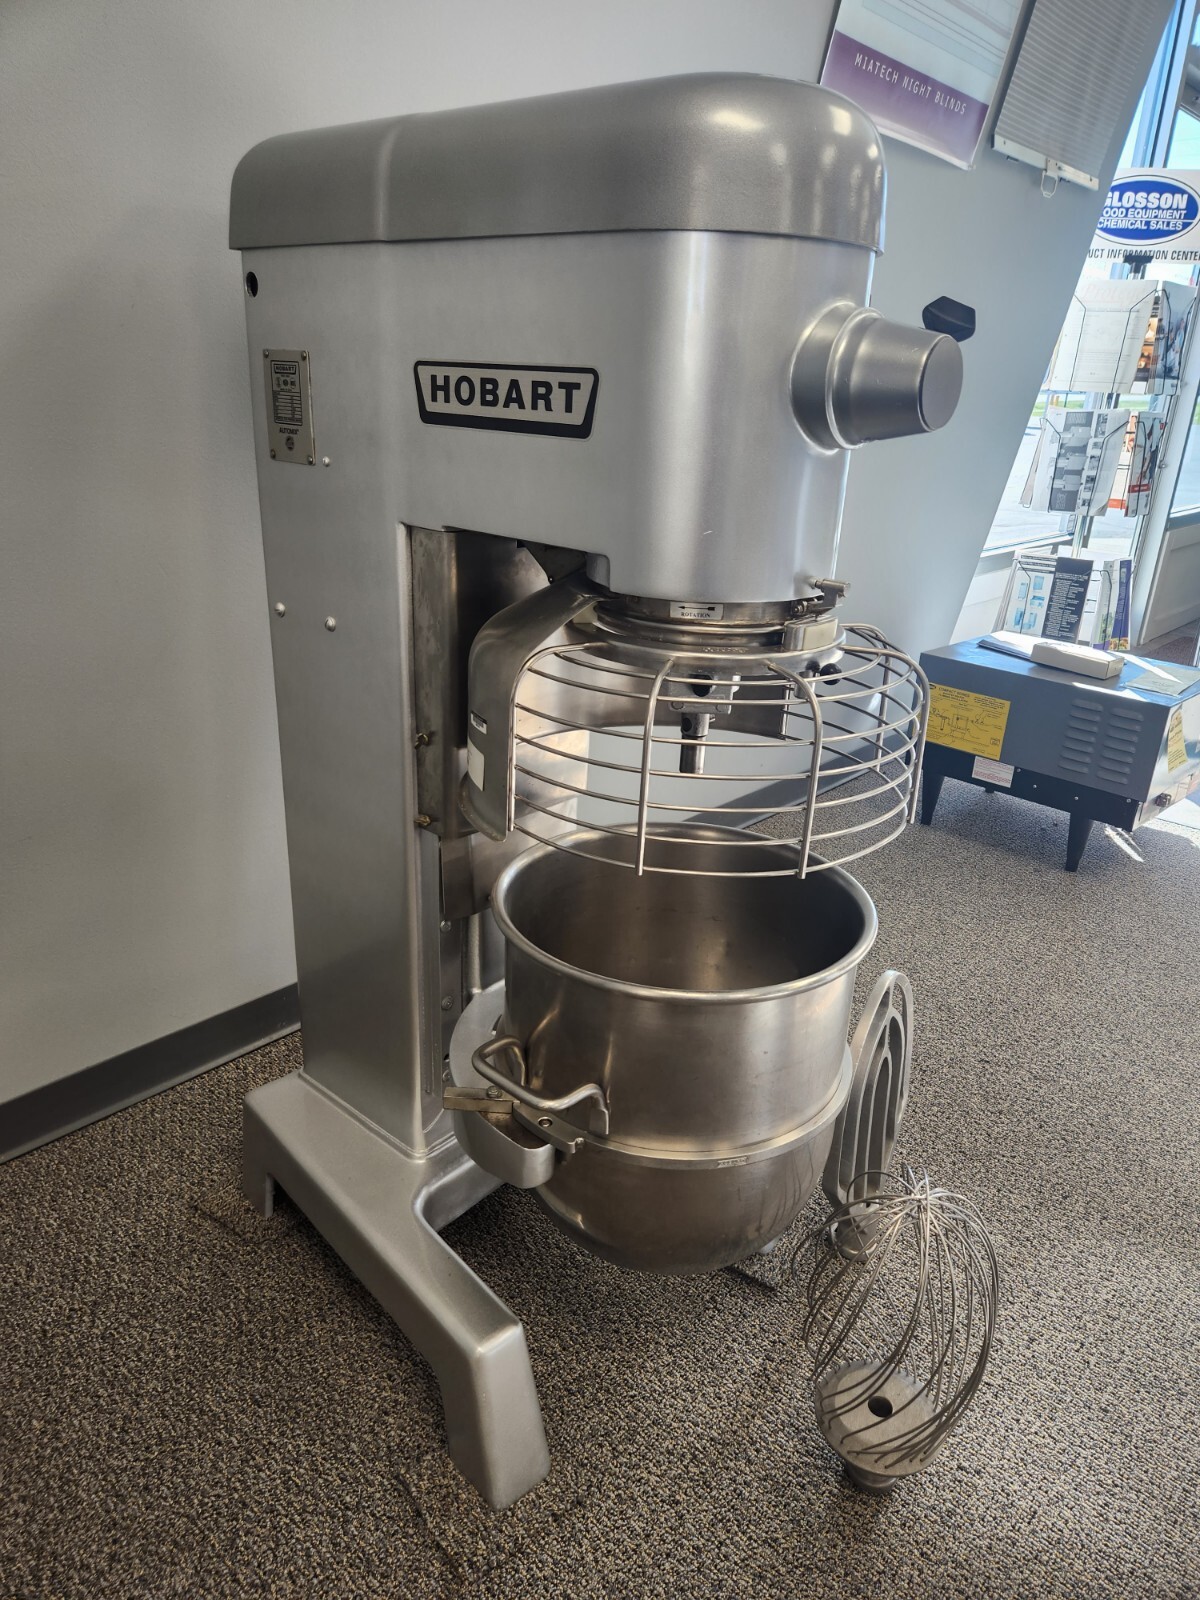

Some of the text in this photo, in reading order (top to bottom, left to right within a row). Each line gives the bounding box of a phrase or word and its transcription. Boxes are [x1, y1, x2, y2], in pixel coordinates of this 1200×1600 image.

[854, 52, 967, 115] MIATECH NIGHT BLINDS
[1102, 207, 1187, 219] OOD EQUIPMENT
[1097, 218, 1183, 230] CHEMICAL SALES
[1088, 248, 1105, 259] UCT
[1170, 250, 1200, 261] CENTE
[430, 374, 581, 414] HOBART
